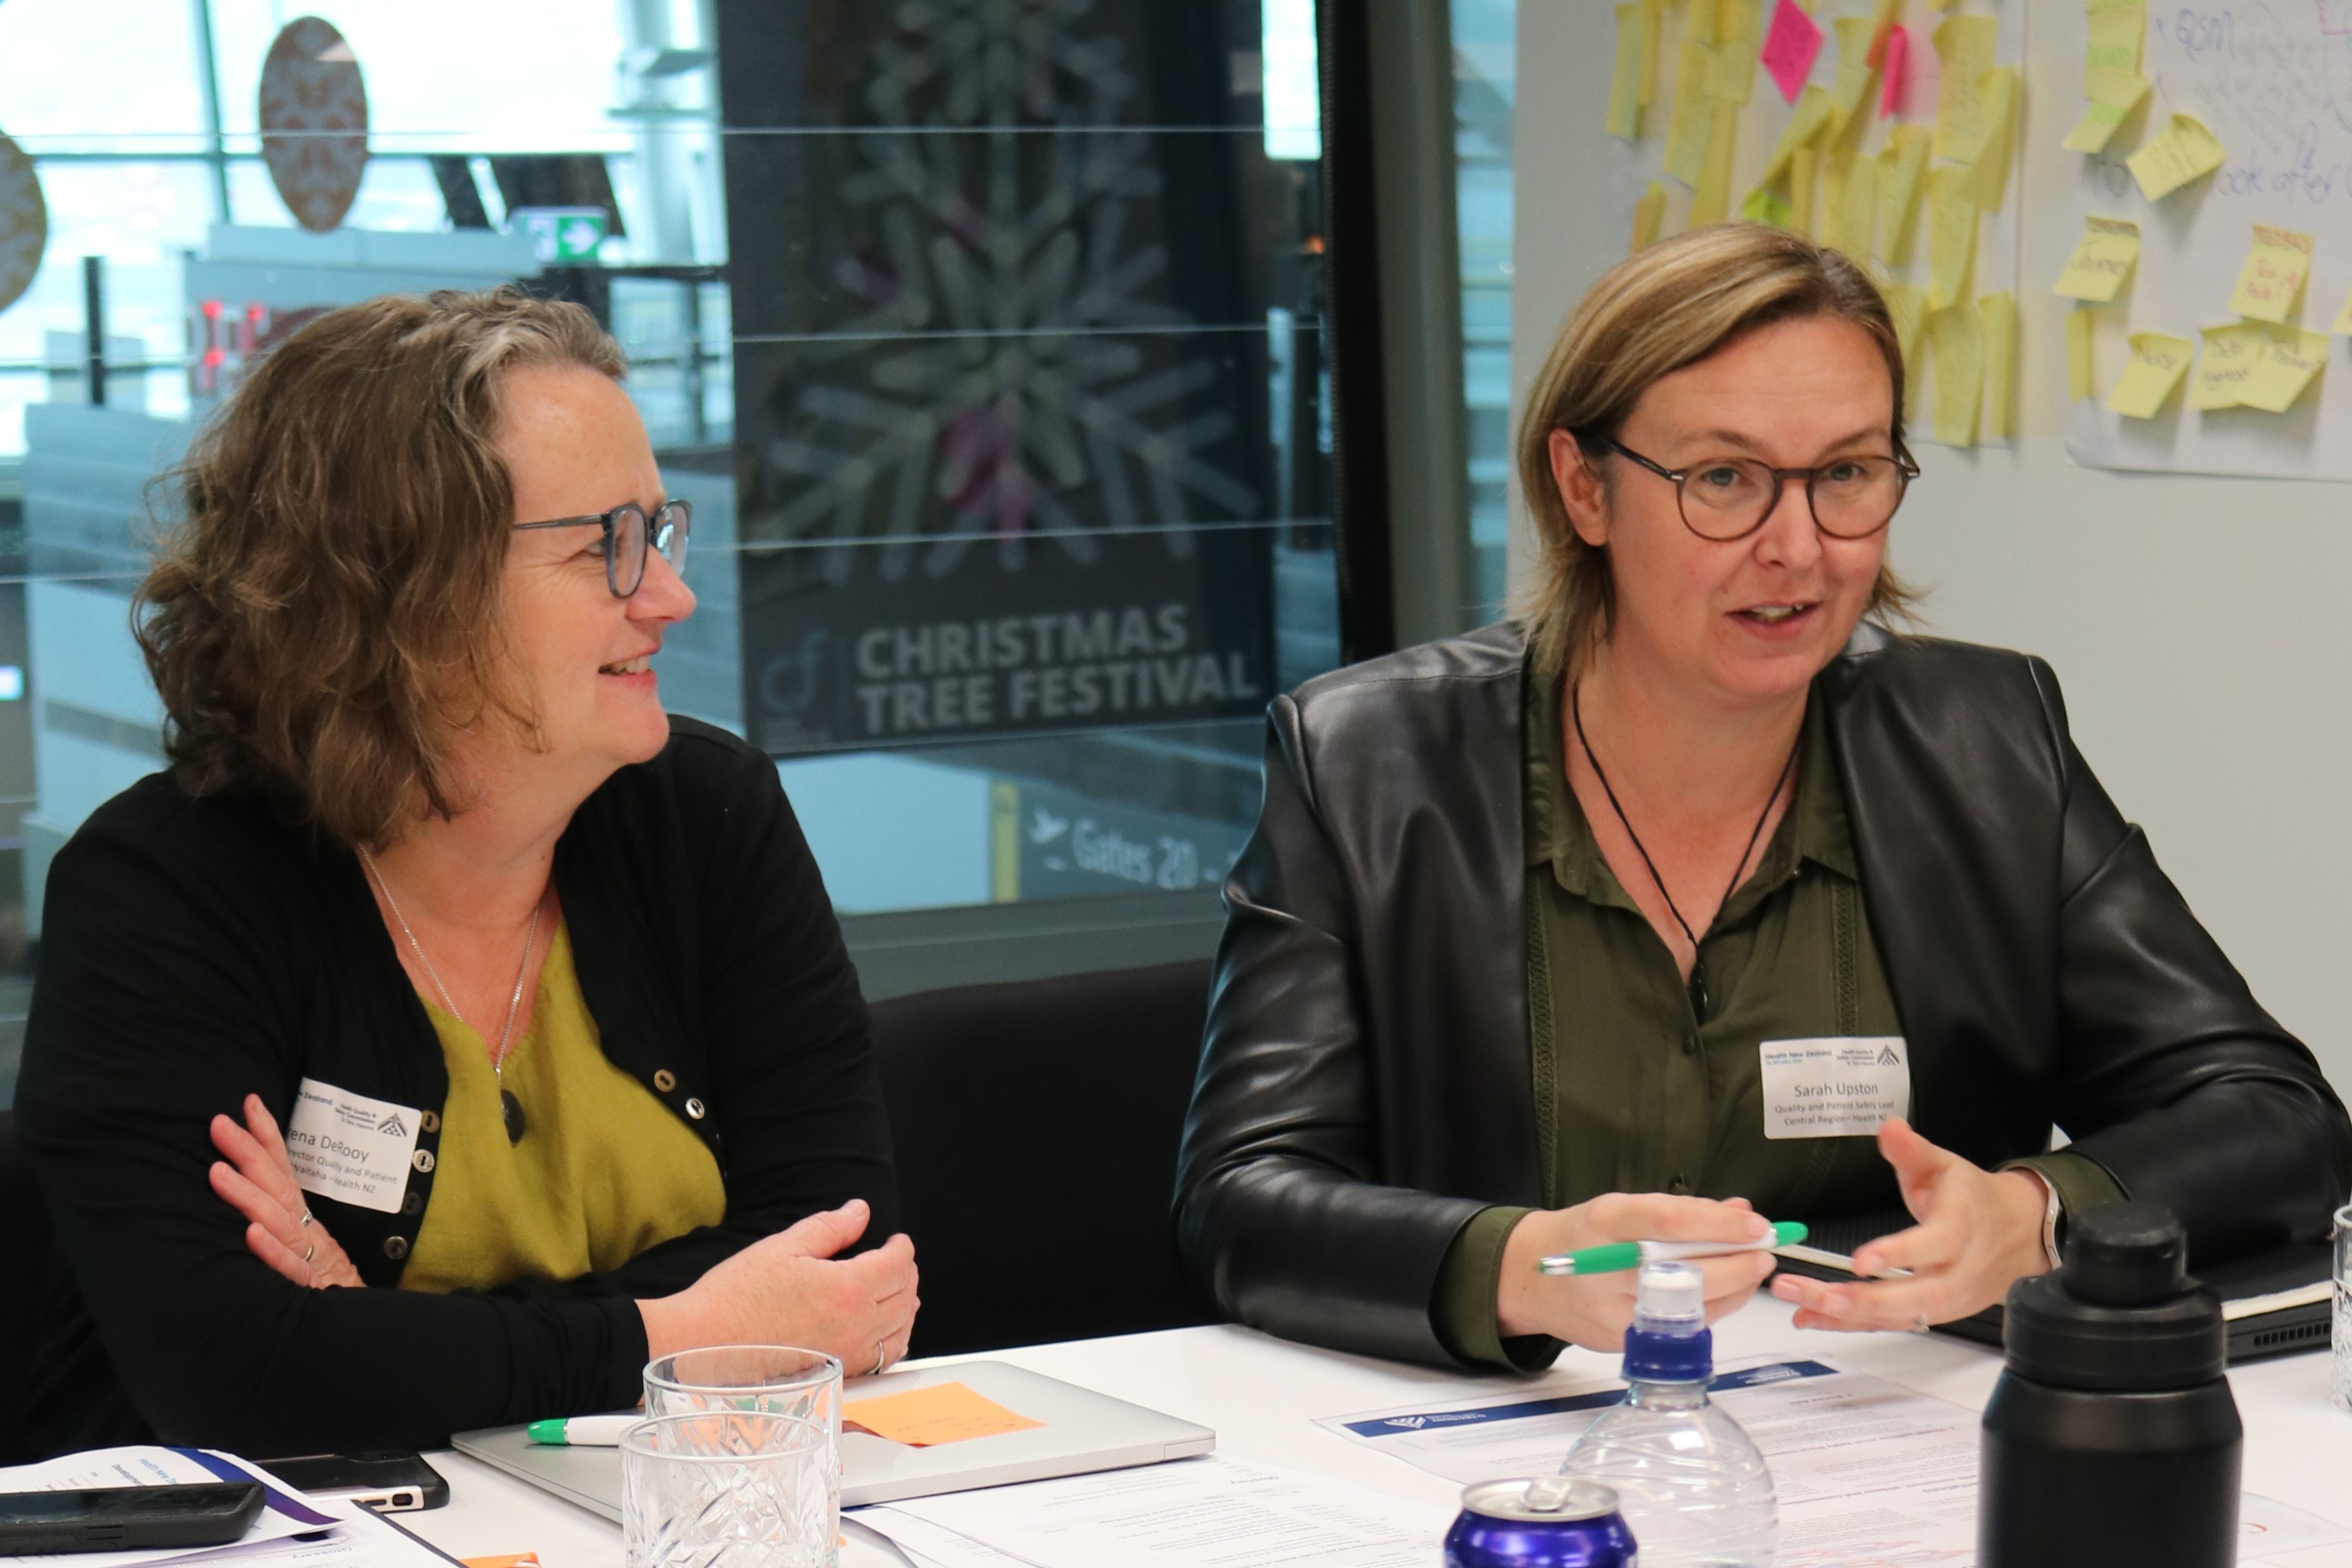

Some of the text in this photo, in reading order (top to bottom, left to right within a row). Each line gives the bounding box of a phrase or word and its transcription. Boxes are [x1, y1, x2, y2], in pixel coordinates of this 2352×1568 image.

[855, 602, 1190, 681] CHRISTMAS
[856, 673, 997, 735] TREE
[1013, 651, 1262, 721] FESTIVAL
[1073, 817, 1153, 885] Gates
[1156, 833, 1199, 890] 20
[1794, 1082, 1879, 1098] Sarah Upston
[303, 1091, 333, 1106] Zealand
[1775, 1101, 1895, 1114] Quality and Patient Safety Lead
[1784, 1116, 1816, 1126] Central
[1853, 1113, 1877, 1122] Health
[320, 1135, 370, 1163] DeRooy
[317, 1156, 343, 1173] Quality
[343, 1167, 362, 1177] and
[364, 1169, 398, 1185] Patient
[362, 1183, 377, 1194] NZ
[292, 1547, 353, 1560] Glossary
